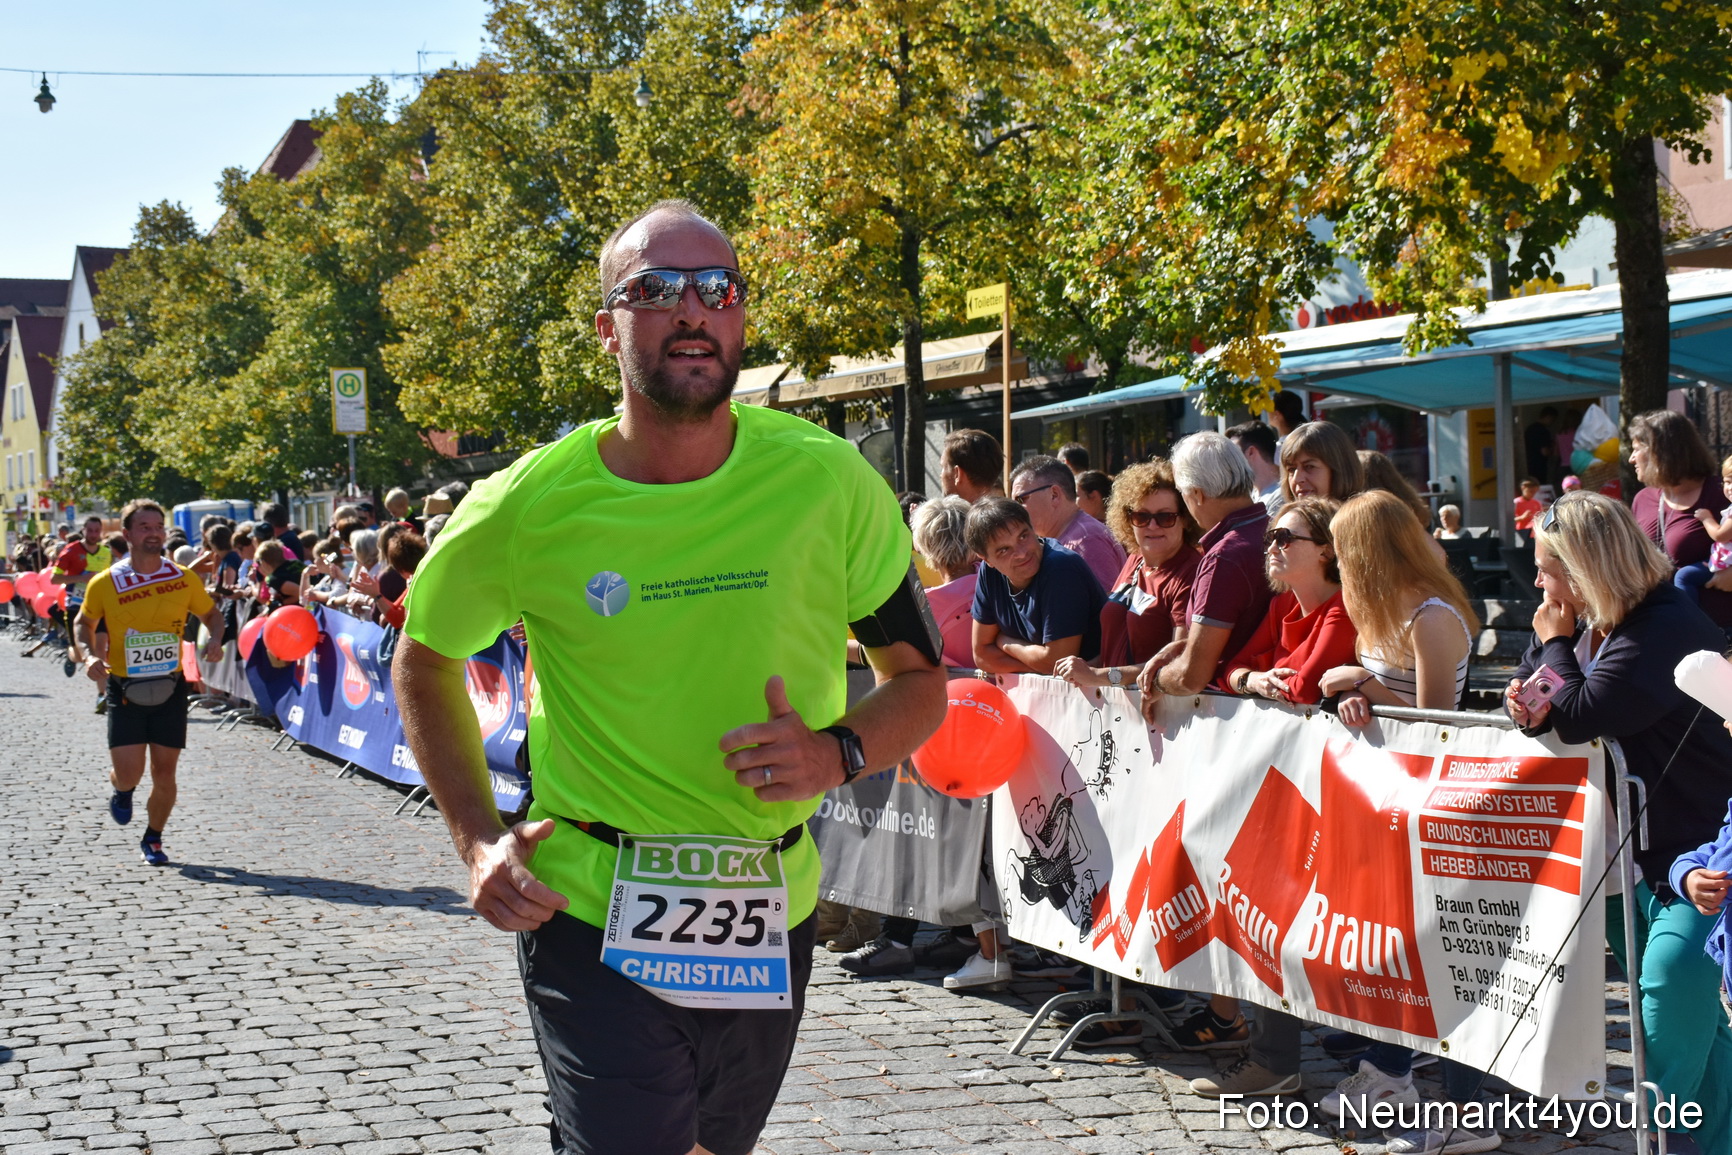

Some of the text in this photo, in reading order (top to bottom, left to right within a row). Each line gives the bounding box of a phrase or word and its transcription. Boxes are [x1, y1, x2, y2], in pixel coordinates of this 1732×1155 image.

[974, 294, 1003, 309] Toiletten
[118, 580, 188, 605] MAX BÖGL
[641, 569, 769, 592] Freie katholische Volksschule
[641, 579, 769, 602] im Haus St. Marien, Neumarkt/Opf.
[131, 634, 173, 646] BOCK
[132, 646, 173, 664] 2406
[139, 664, 170, 672] MARCO
[1431, 790, 1558, 813] VERZURRSYSTEME
[1426, 822, 1550, 847] RUNDSCHLINGEN
[636, 845, 767, 877] BOCK
[1304, 830, 1321, 871] Seit 1929
[1430, 855, 1531, 879] HEBEBÄNDER
[774, 902, 781, 912] D
[1147, 884, 1206, 946] Braun
[1216, 859, 1279, 959] Braun
[1435, 894, 1521, 917] Braun GmbH
[631, 894, 769, 947] 2235
[1439, 916, 1530, 944] Am Grünberg 8
[1302, 891, 1412, 980] Braun
[1442, 936, 1565, 983] D-92318 Neumarkt-Png
[620, 958, 770, 987] CHRISTIAN
[1448, 965, 1473, 982] Tel.
[1475, 968, 1505, 989] 09181
[1344, 977, 1431, 1007] Sicher ist sicher
[1454, 985, 1476, 1003] Fax
[1479, 989, 1504, 1012] 09181
